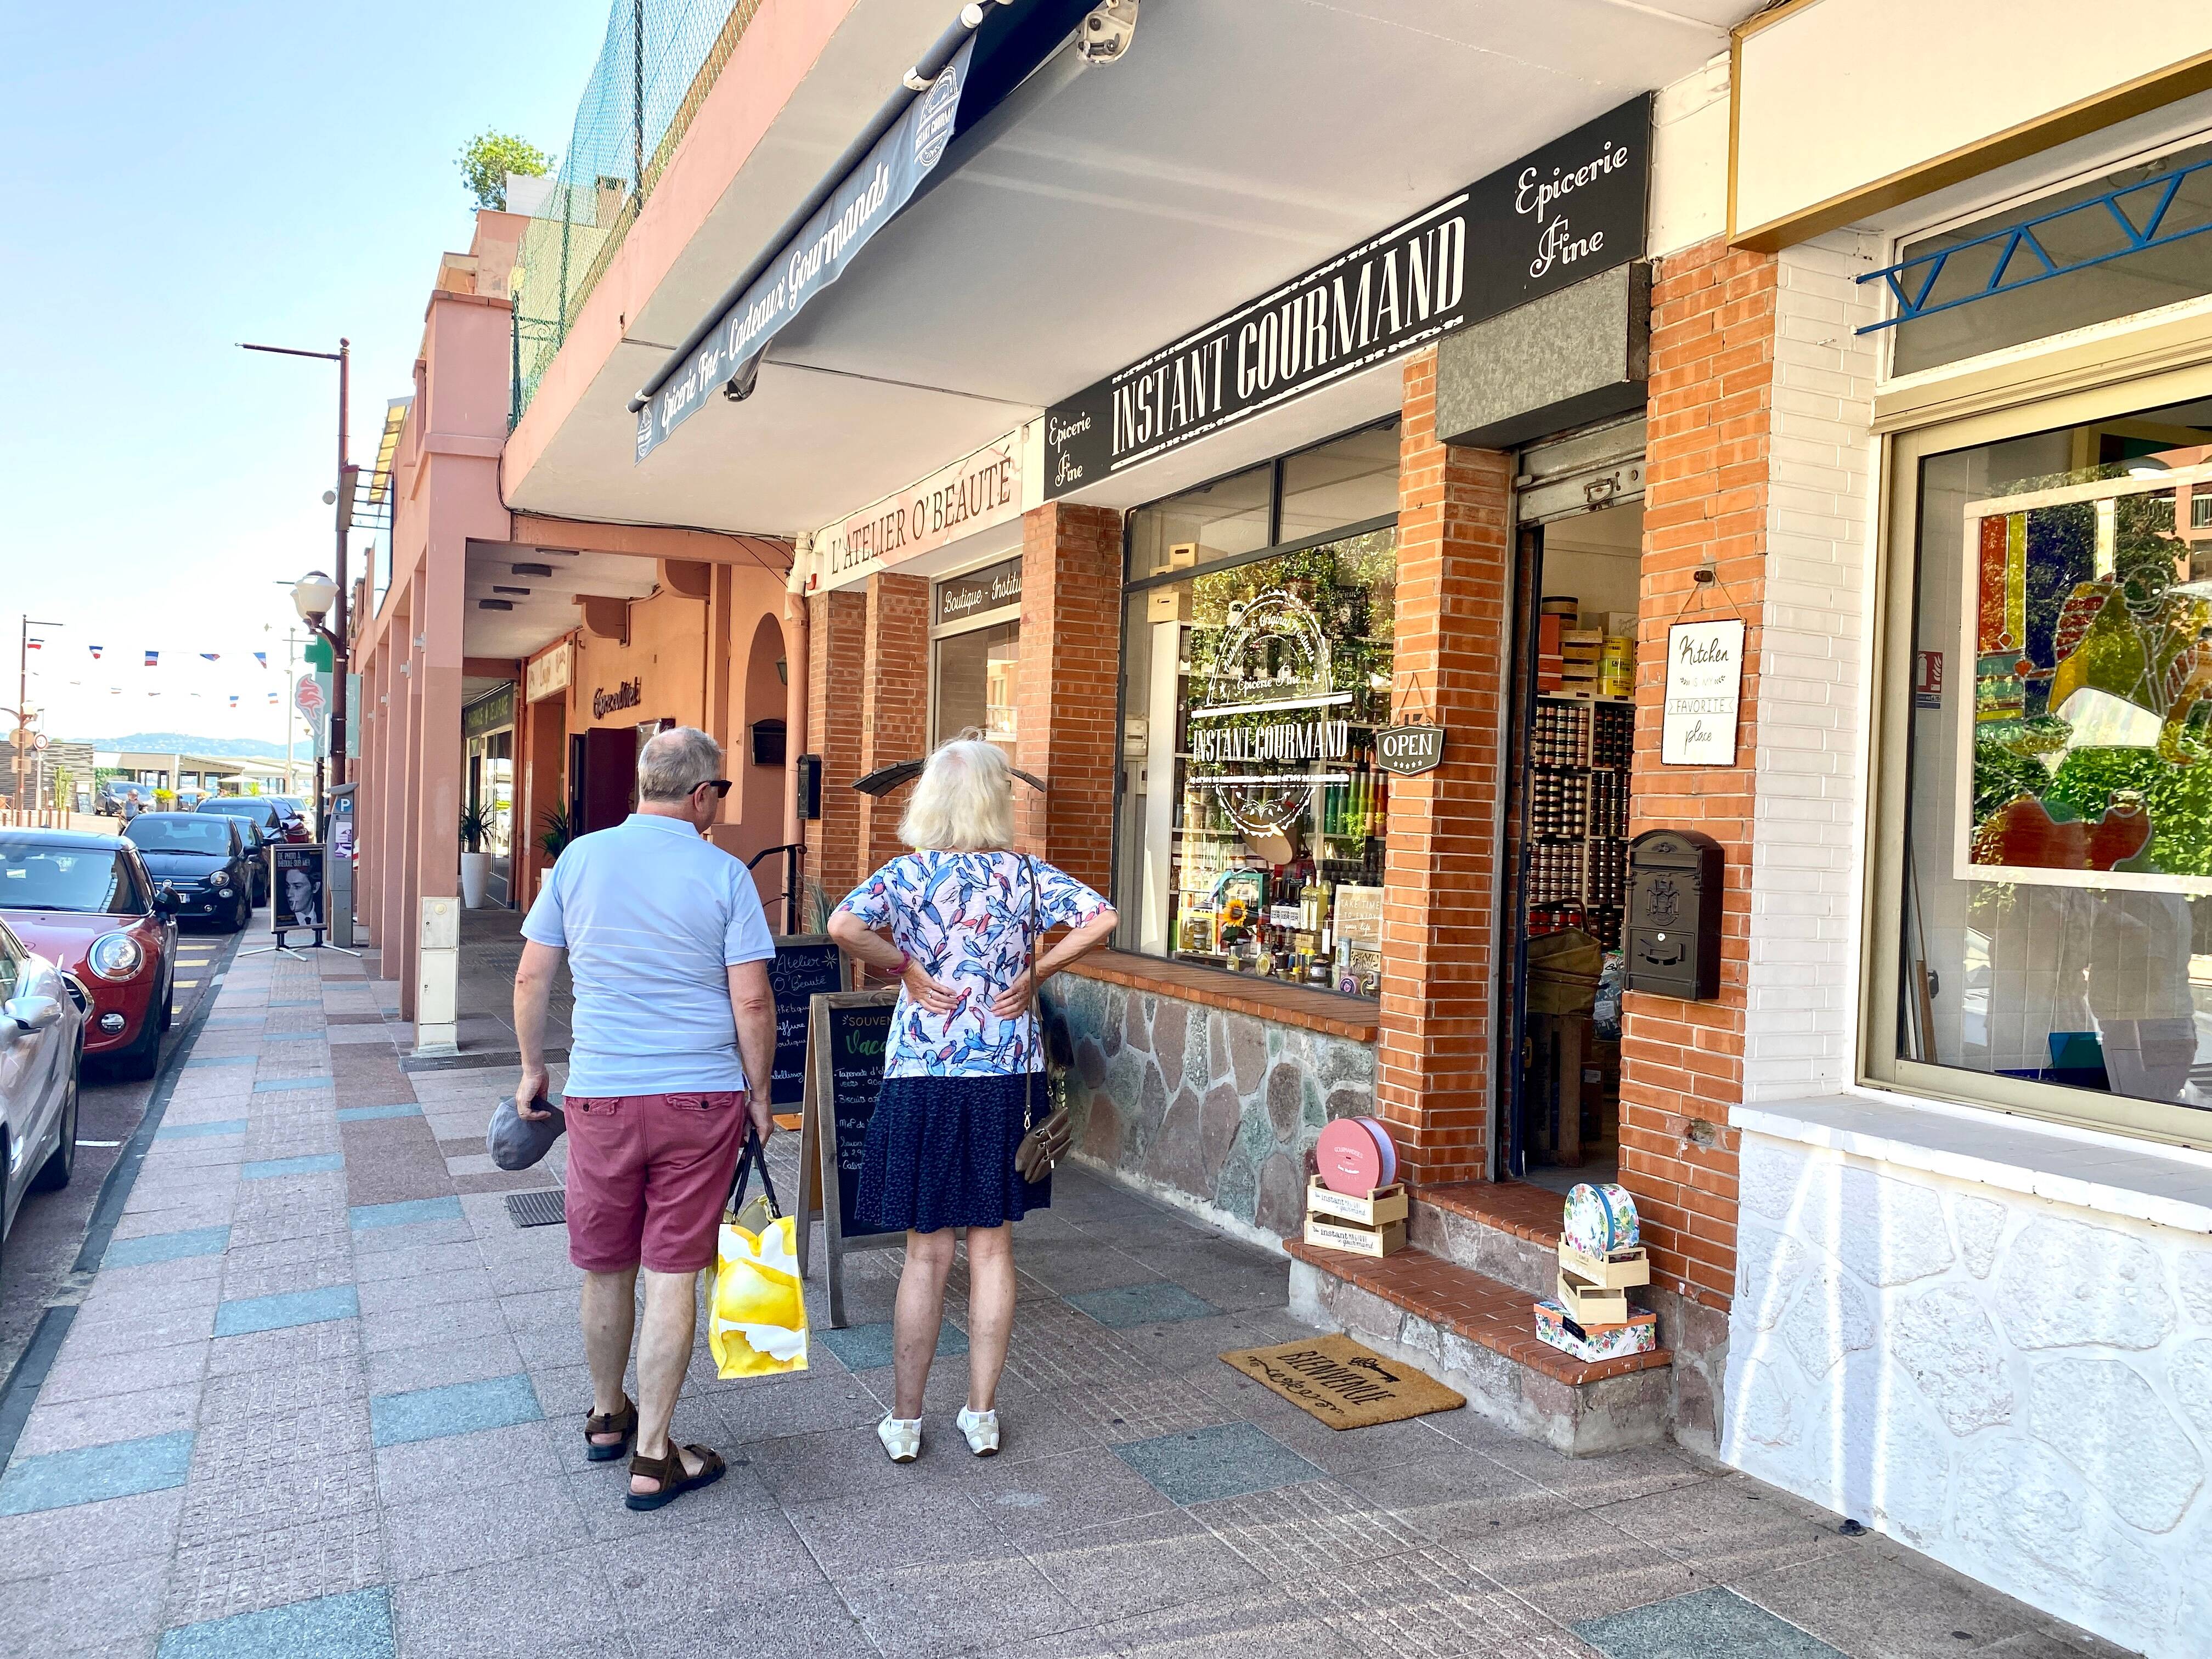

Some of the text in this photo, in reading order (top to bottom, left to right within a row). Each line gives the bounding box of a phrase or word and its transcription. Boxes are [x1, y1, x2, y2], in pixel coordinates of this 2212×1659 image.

[1515, 141, 1628, 223] Epicerie
[1530, 214, 1604, 278] Fine
[662, 369, 696, 435] Epicerie
[698, 348, 719, 392] Fine
[729, 275, 785, 361] Cadeaux
[788, 161, 889, 311] Gourmands
[1111, 216, 1466, 456] INSTANT GOURMAND
[1049, 411, 1091, 453] Epicerie
[1055, 450, 1083, 487] Fine
[832, 444, 1011, 575] L'ATELIER O'BEAUTÉ
[944, 587, 983, 615] Boutique
[991, 571, 1022, 600] Institu
[1259, 612, 1291, 628] Original
[1290, 620, 1315, 663] Products
[1679, 635, 1729, 665] Kitchen
[1237, 662, 1301, 697] Epicerie Fine
[1677, 699, 1725, 713] FAVORITE
[1193, 720, 1348, 762] INSTANT GOURMAND
[1383, 733, 1433, 757] OPEN
[1684, 720, 1712, 755] place
[1341, 899, 1380, 910] TAKE TIME
[1345, 922, 1372, 936] your life
[777, 1020, 805, 1036] oiffure
[849, 1016, 891, 1026] SOUVEN
[776, 1039, 806, 1048] outique
[1322, 1194, 1344, 1206] instant
[1340, 1204, 1366, 1216] gourmand
[1321, 1228, 1348, 1240] instant
[1348, 1233, 1368, 1243] MAGIQUE
[1342, 1238, 1374, 1250] gourmand
[1276, 1350, 1396, 1406] BIENVENUE
